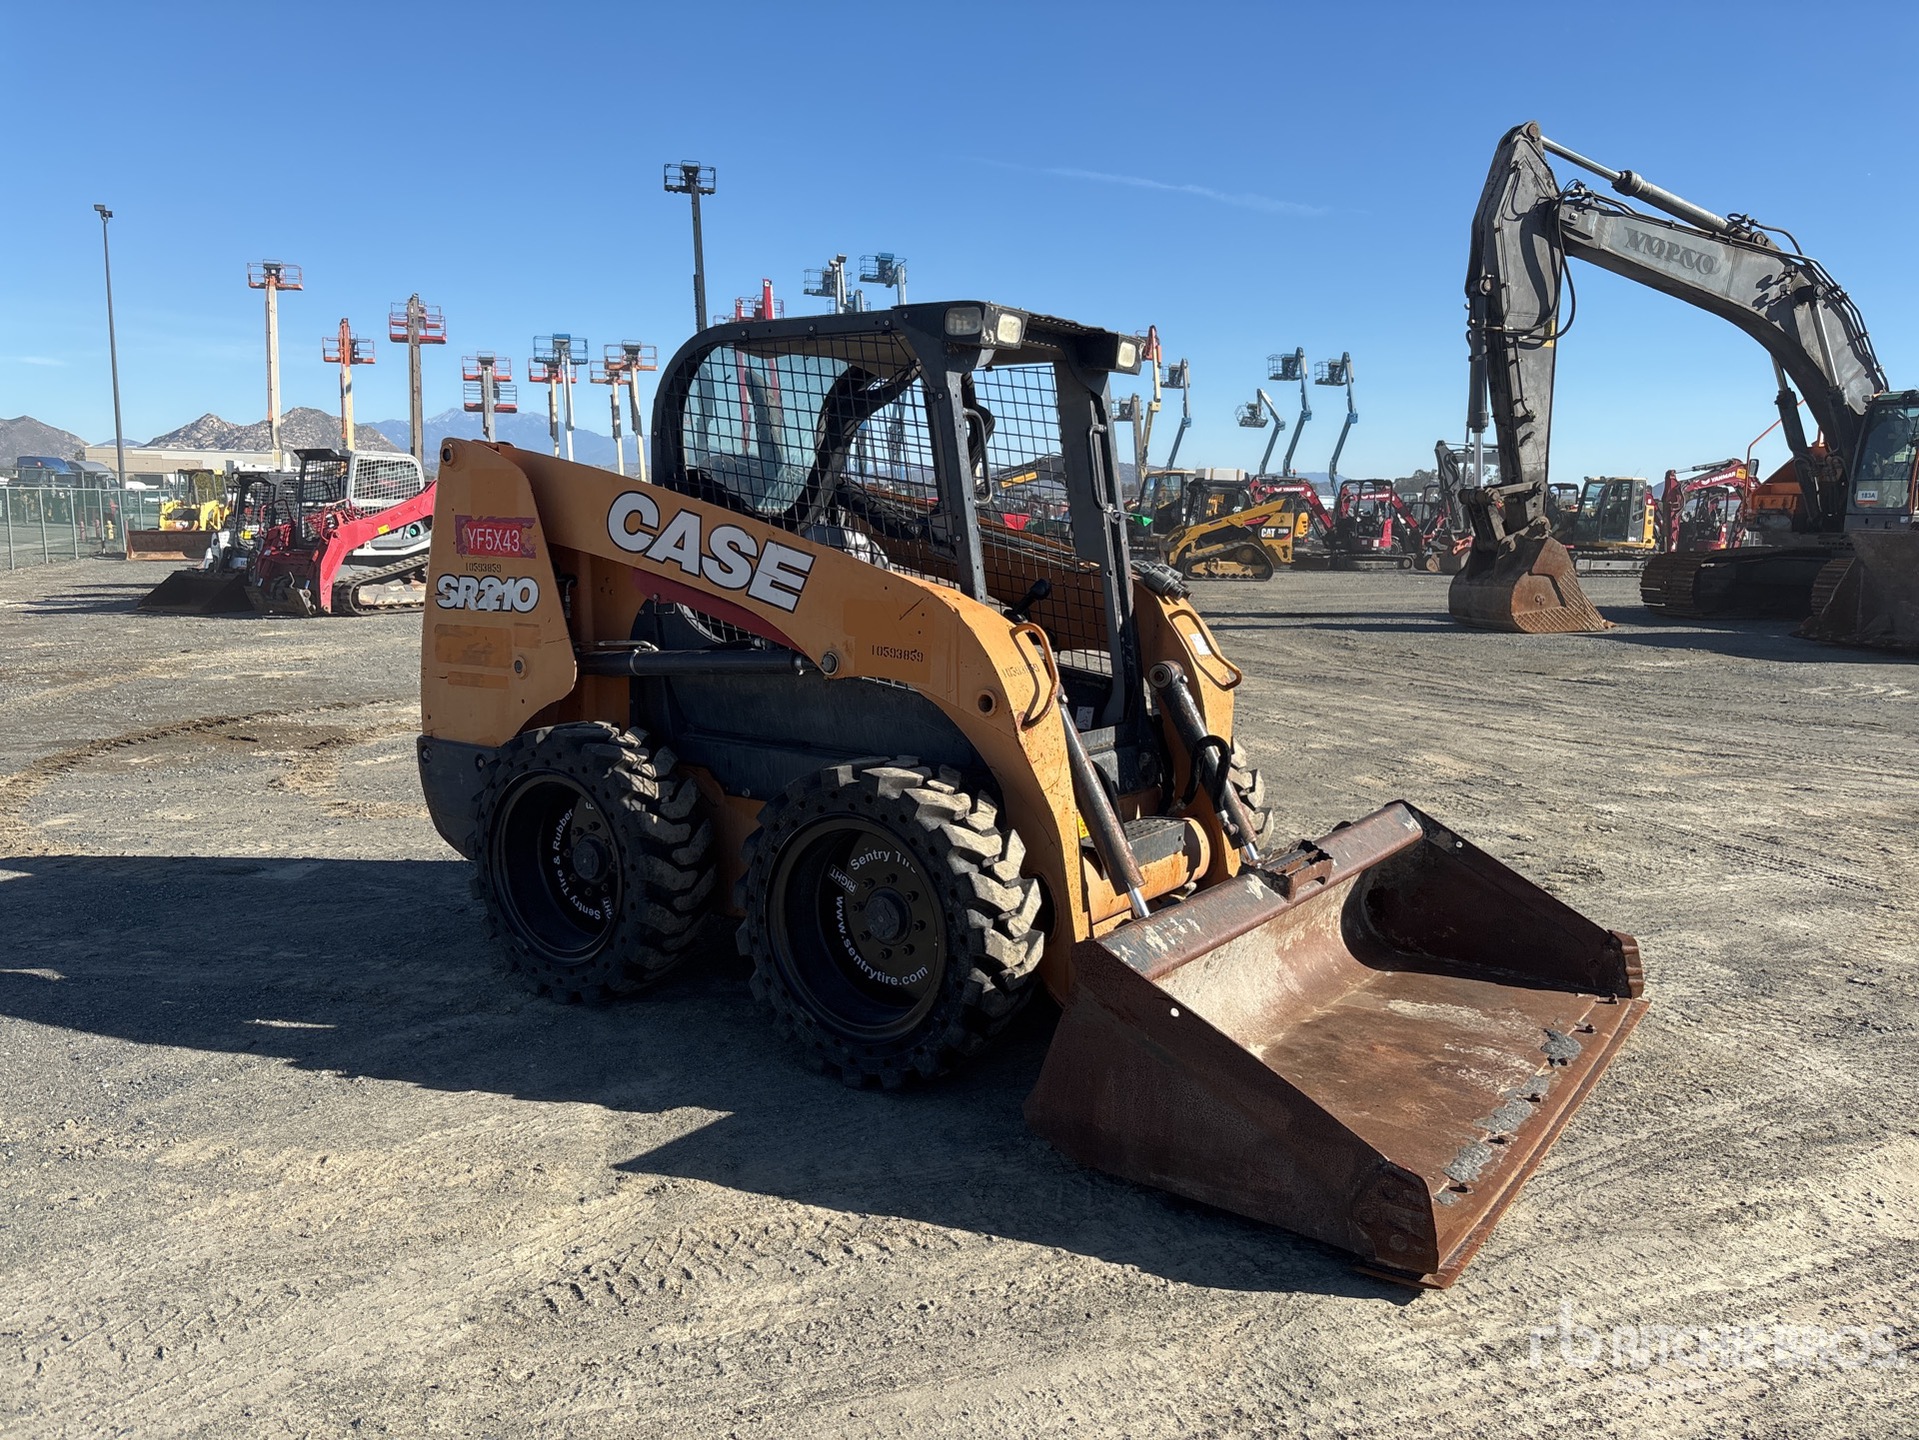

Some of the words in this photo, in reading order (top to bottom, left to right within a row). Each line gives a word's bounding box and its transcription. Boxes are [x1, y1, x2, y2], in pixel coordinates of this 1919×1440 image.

[1710, 470, 1736, 482] YANMAR
[467, 528, 520, 552] YF5X43
[1261, 528, 1276, 538] CAT
[607, 490, 816, 614] CASE
[465, 562, 502, 573] 10593859
[435, 573, 540, 613] SR210
[871, 644, 924, 663] 10593859
[552, 808, 573, 851] Rubber
[553, 855, 561, 865] &
[850, 849, 891, 871] Sentry
[557, 869, 570, 896] Tire
[829, 868, 857, 893] RIGHT
[570, 894, 601, 920] Sentry
[836, 896, 929, 986] www.sentrytire.com
